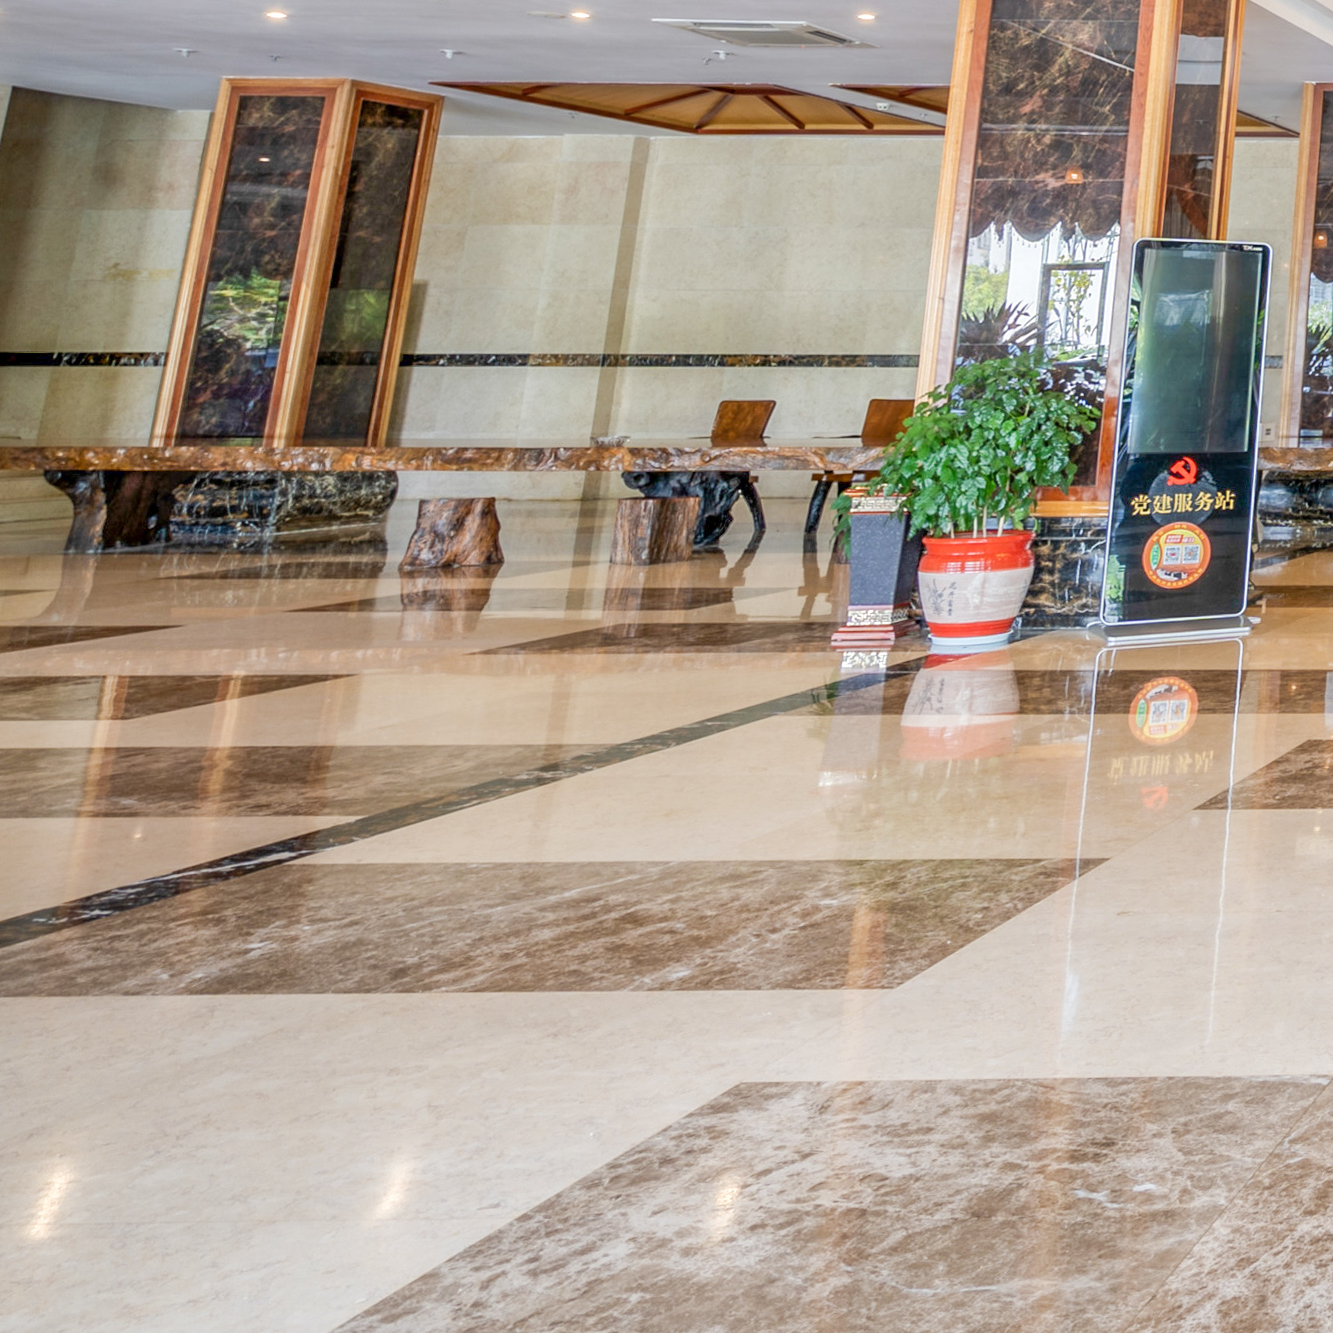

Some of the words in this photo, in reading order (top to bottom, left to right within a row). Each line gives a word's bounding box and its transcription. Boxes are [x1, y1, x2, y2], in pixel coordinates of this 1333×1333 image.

[1130, 489, 1237, 517] 党建服务站
